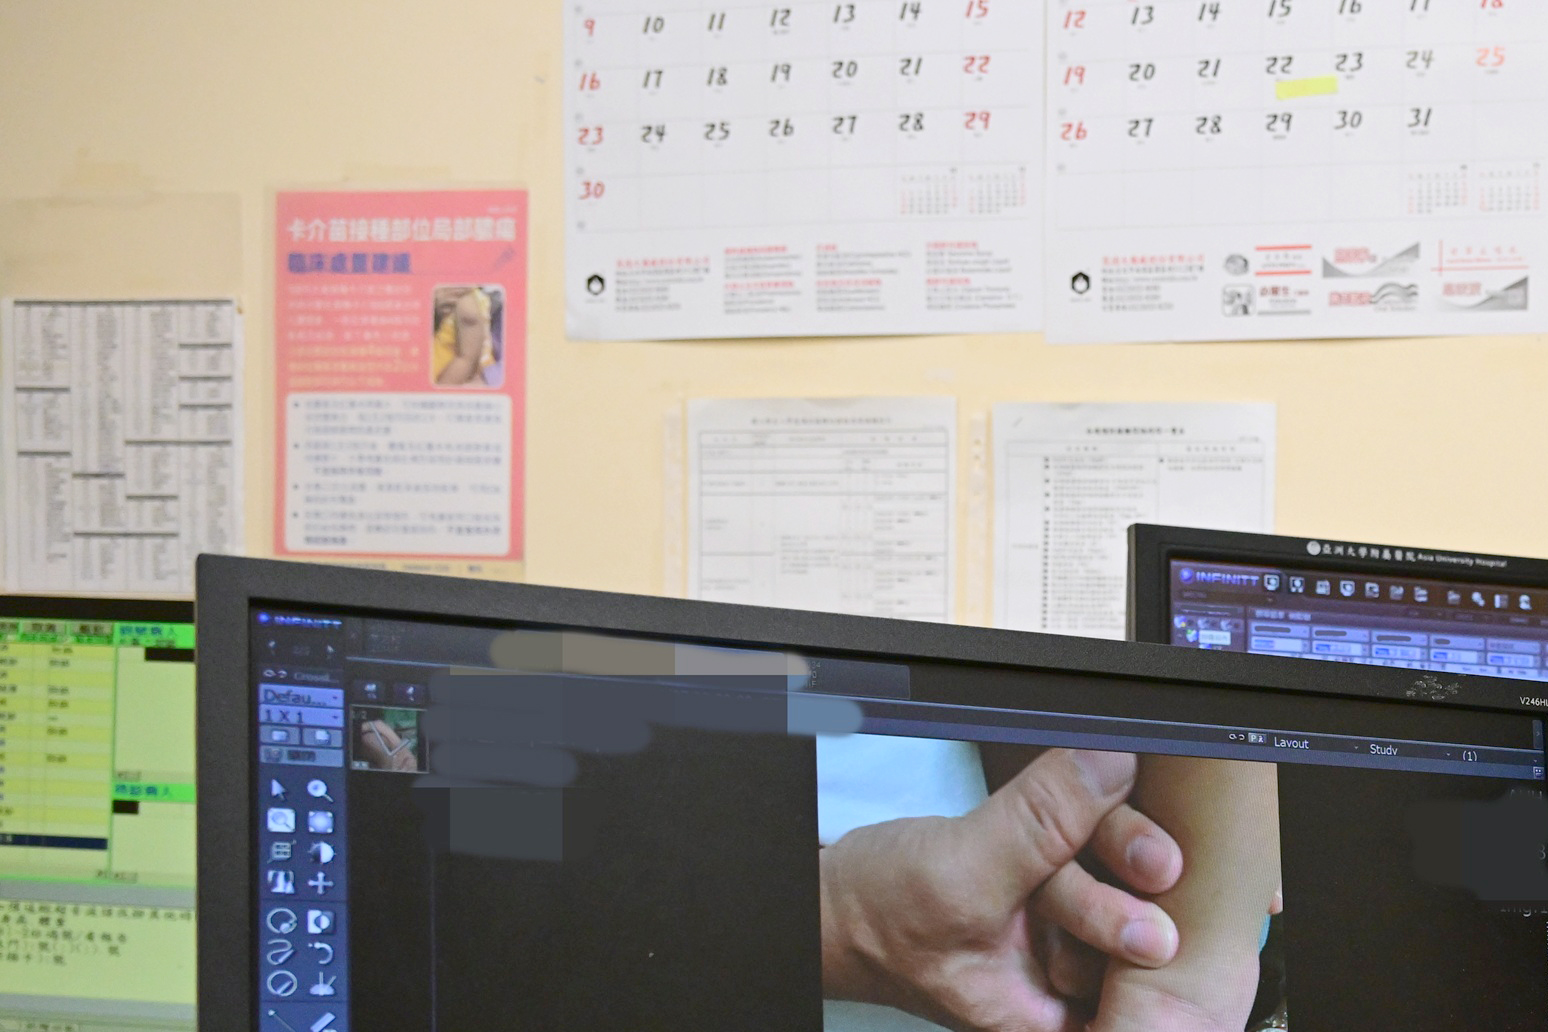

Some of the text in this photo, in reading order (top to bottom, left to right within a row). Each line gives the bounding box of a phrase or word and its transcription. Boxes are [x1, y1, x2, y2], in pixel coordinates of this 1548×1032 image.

[584, 0, 989, 35] 9 10 11 12 13 14 15
[1063, 0, 1430, 29] 12 13 14 15 16 17
[579, 55, 991, 91] 16 17 18 19 20 21 22
[1063, 47, 1506, 85] 19 20 21 22 23 24 25
[578, 111, 991, 145] 23 24 25 26 27 28 29
[1061, 107, 1432, 141] 26 27 28 29 30 31
[580, 181, 605, 200] 30
